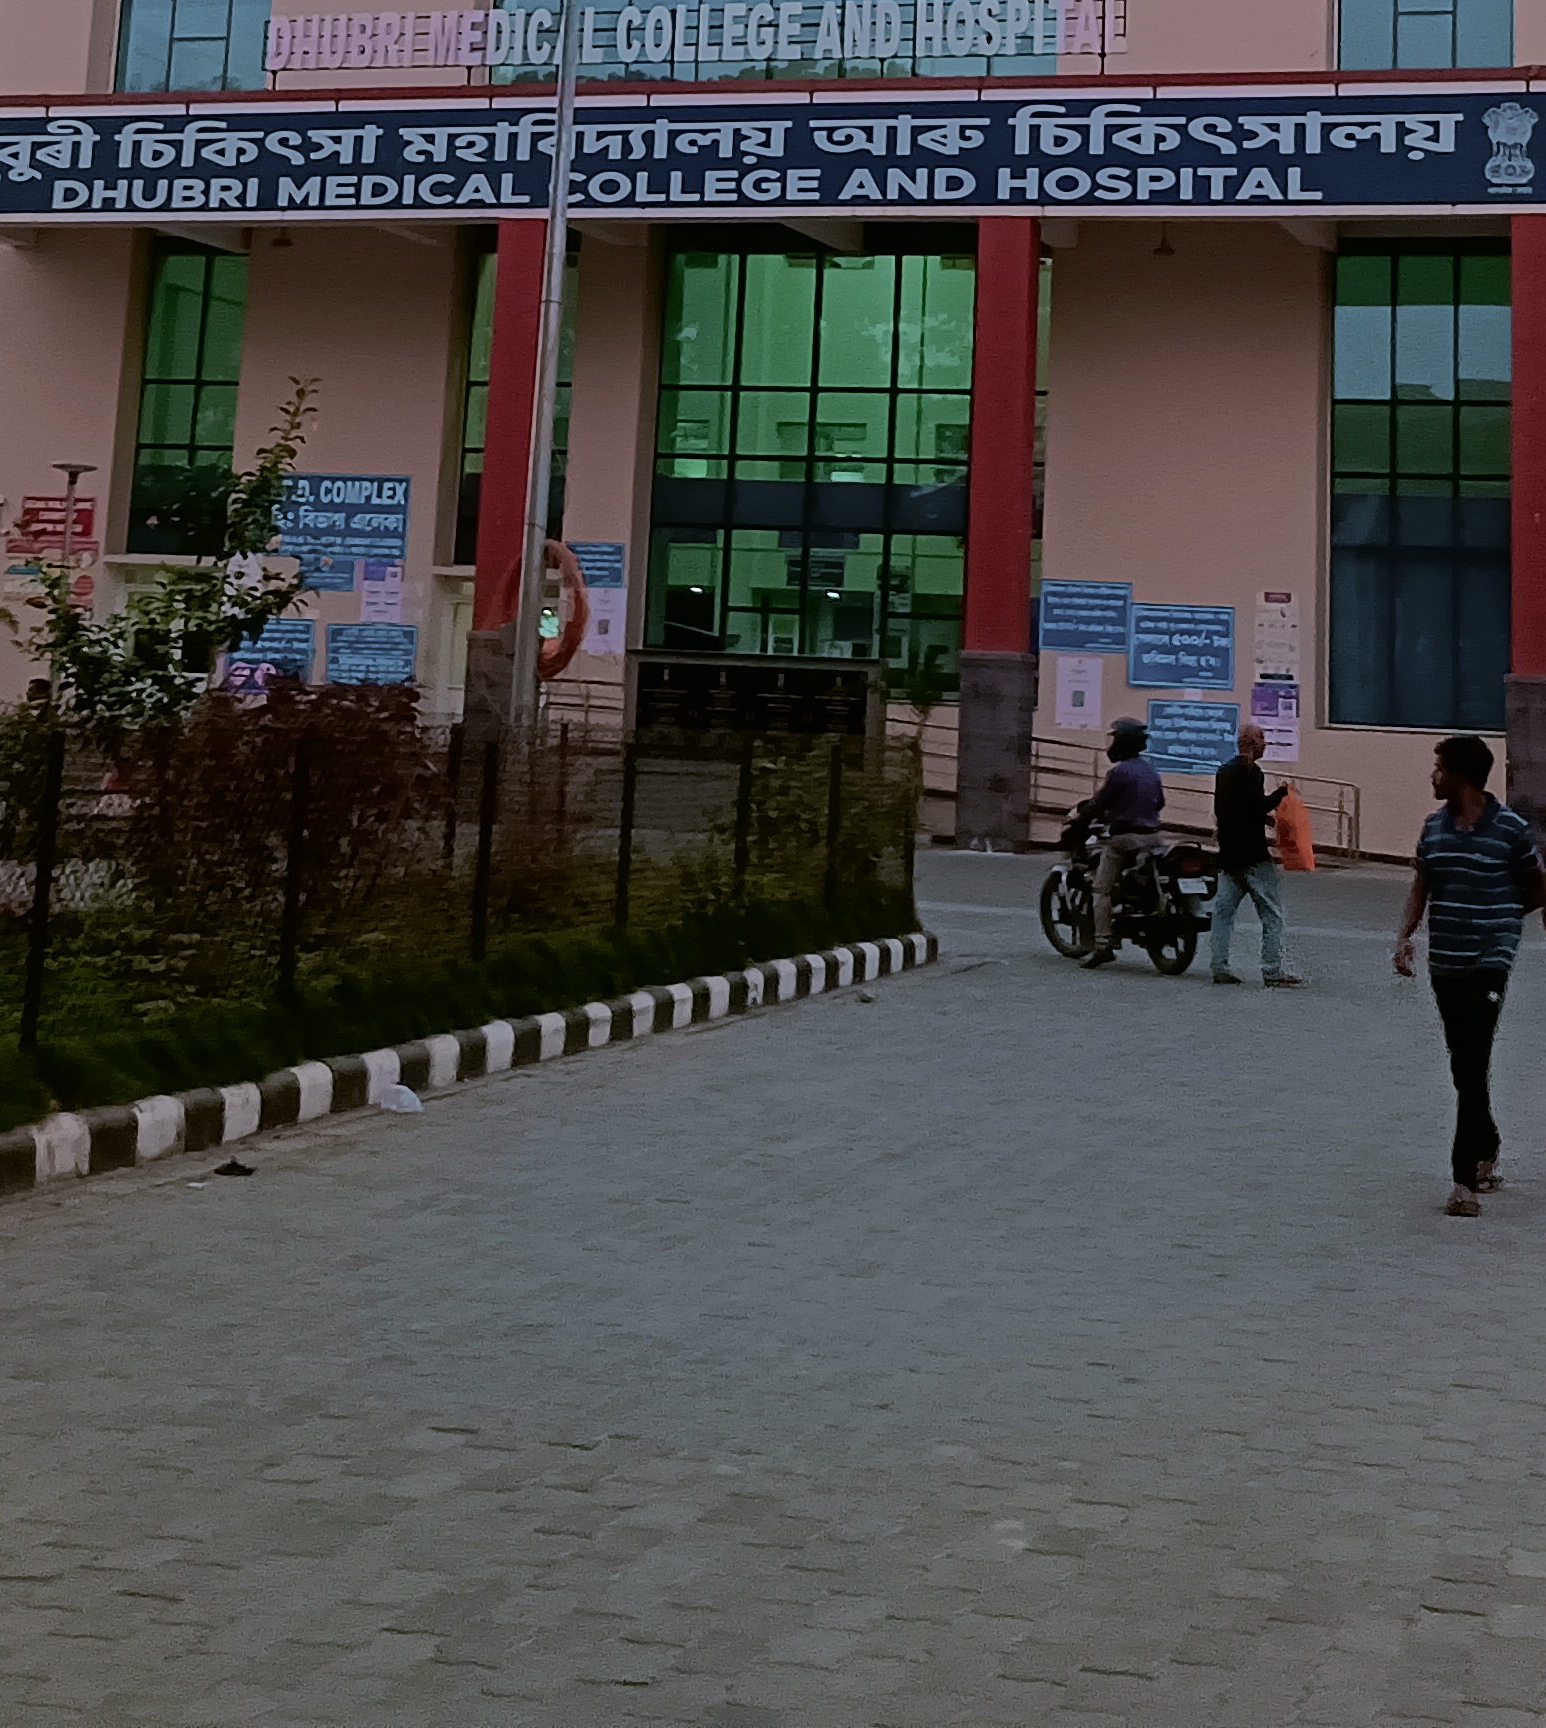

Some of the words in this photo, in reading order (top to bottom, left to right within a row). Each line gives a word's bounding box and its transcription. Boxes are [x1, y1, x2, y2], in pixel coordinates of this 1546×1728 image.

[266, 11, 415, 70] DHUBRI
[428, 7, 603, 66] MEDICL
[616, 2, 803, 63] COLLEGE
[813, 0, 901, 59] AND
[114, 120, 384, 169] চিকিৎসা
[809, 114, 991, 156] আৰু
[1007, 103, 1464, 160] চিকিৎসালয়
[51, 177, 259, 210] DHUBRI
[278, 173, 531, 207] MEDICAL
[837, 167, 977, 200] AND
[997, 167, 1323, 201] HOSPITAL
[319, 479, 407, 505] COMPLEX
